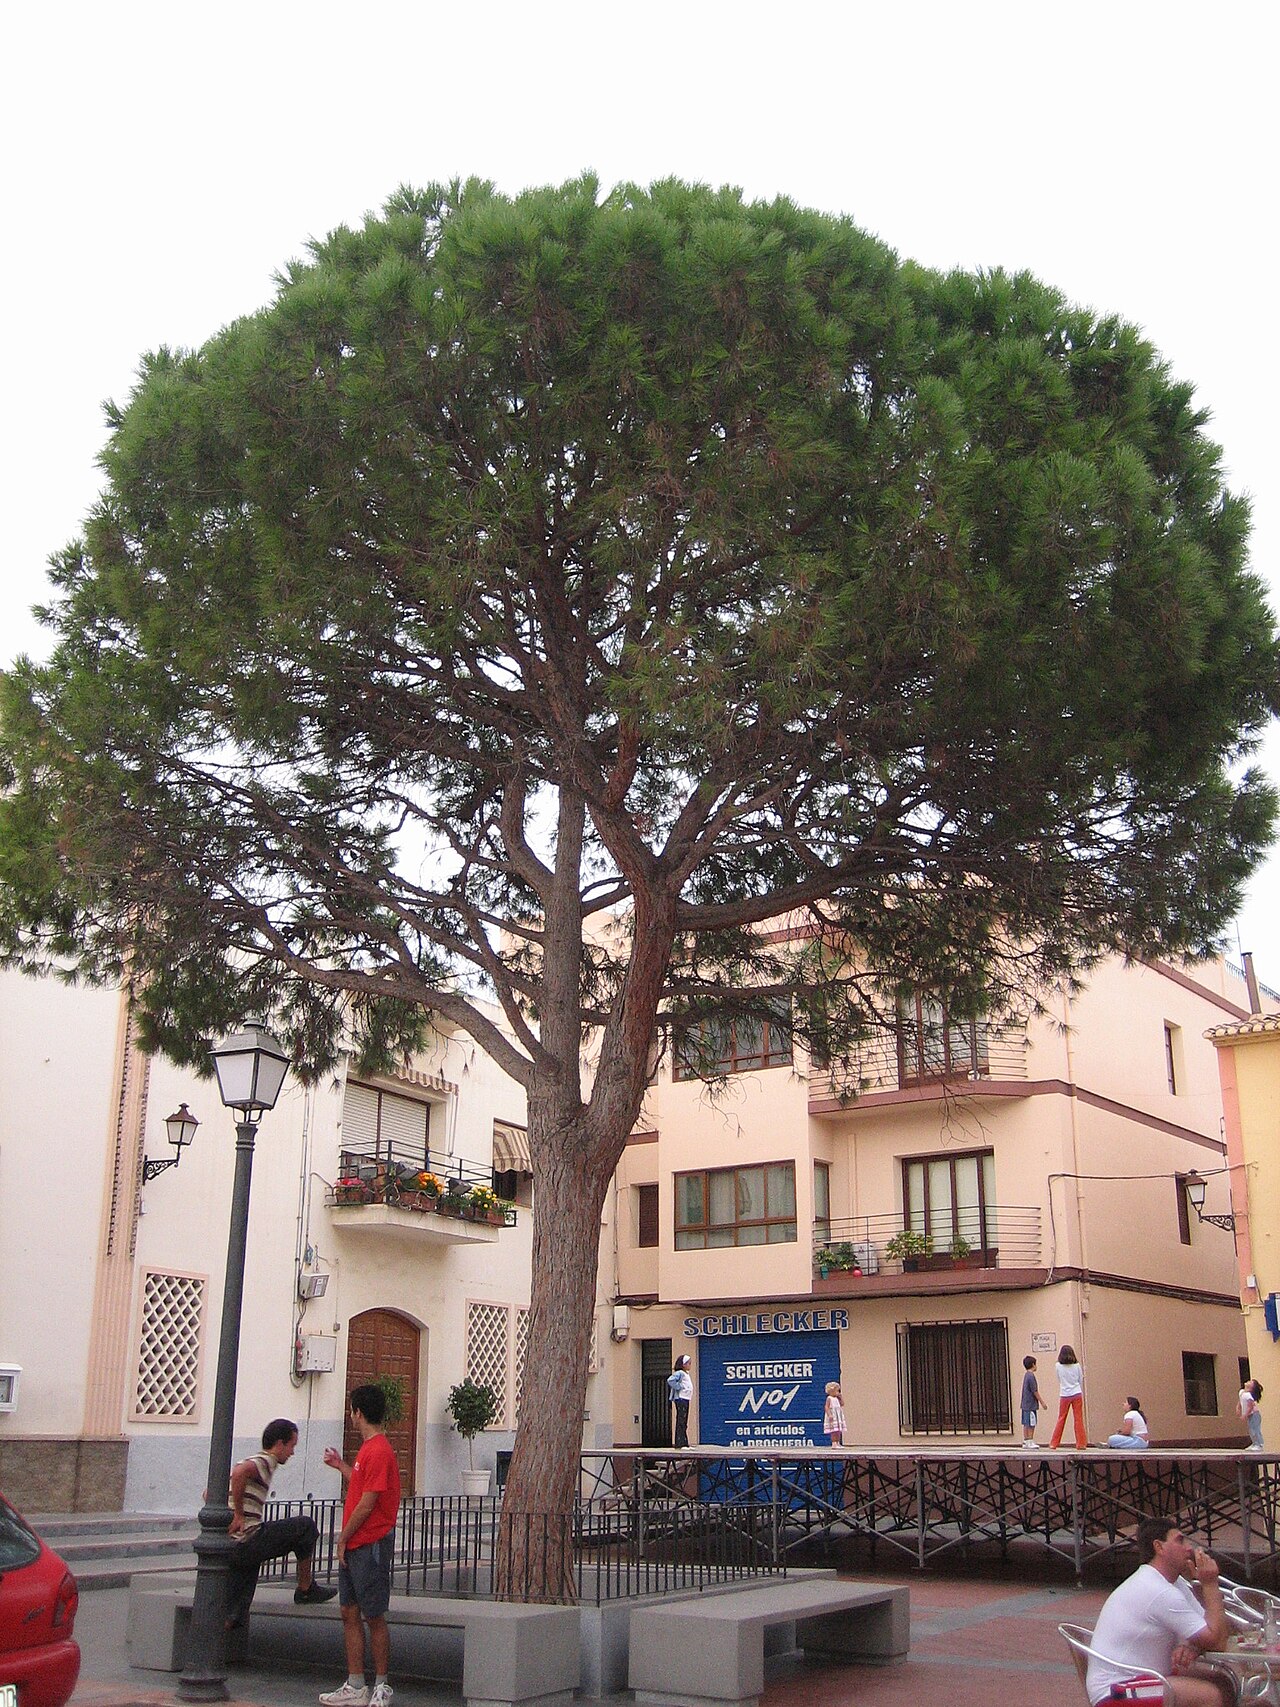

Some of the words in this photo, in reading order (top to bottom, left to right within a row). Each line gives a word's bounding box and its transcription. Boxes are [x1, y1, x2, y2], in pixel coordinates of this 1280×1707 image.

[683, 1309, 849, 1337] SCHLECKER
[726, 1363, 813, 1379] SCHLECKER
[736, 1426, 751, 1435] en
[753, 1424, 805, 1435] artículos
